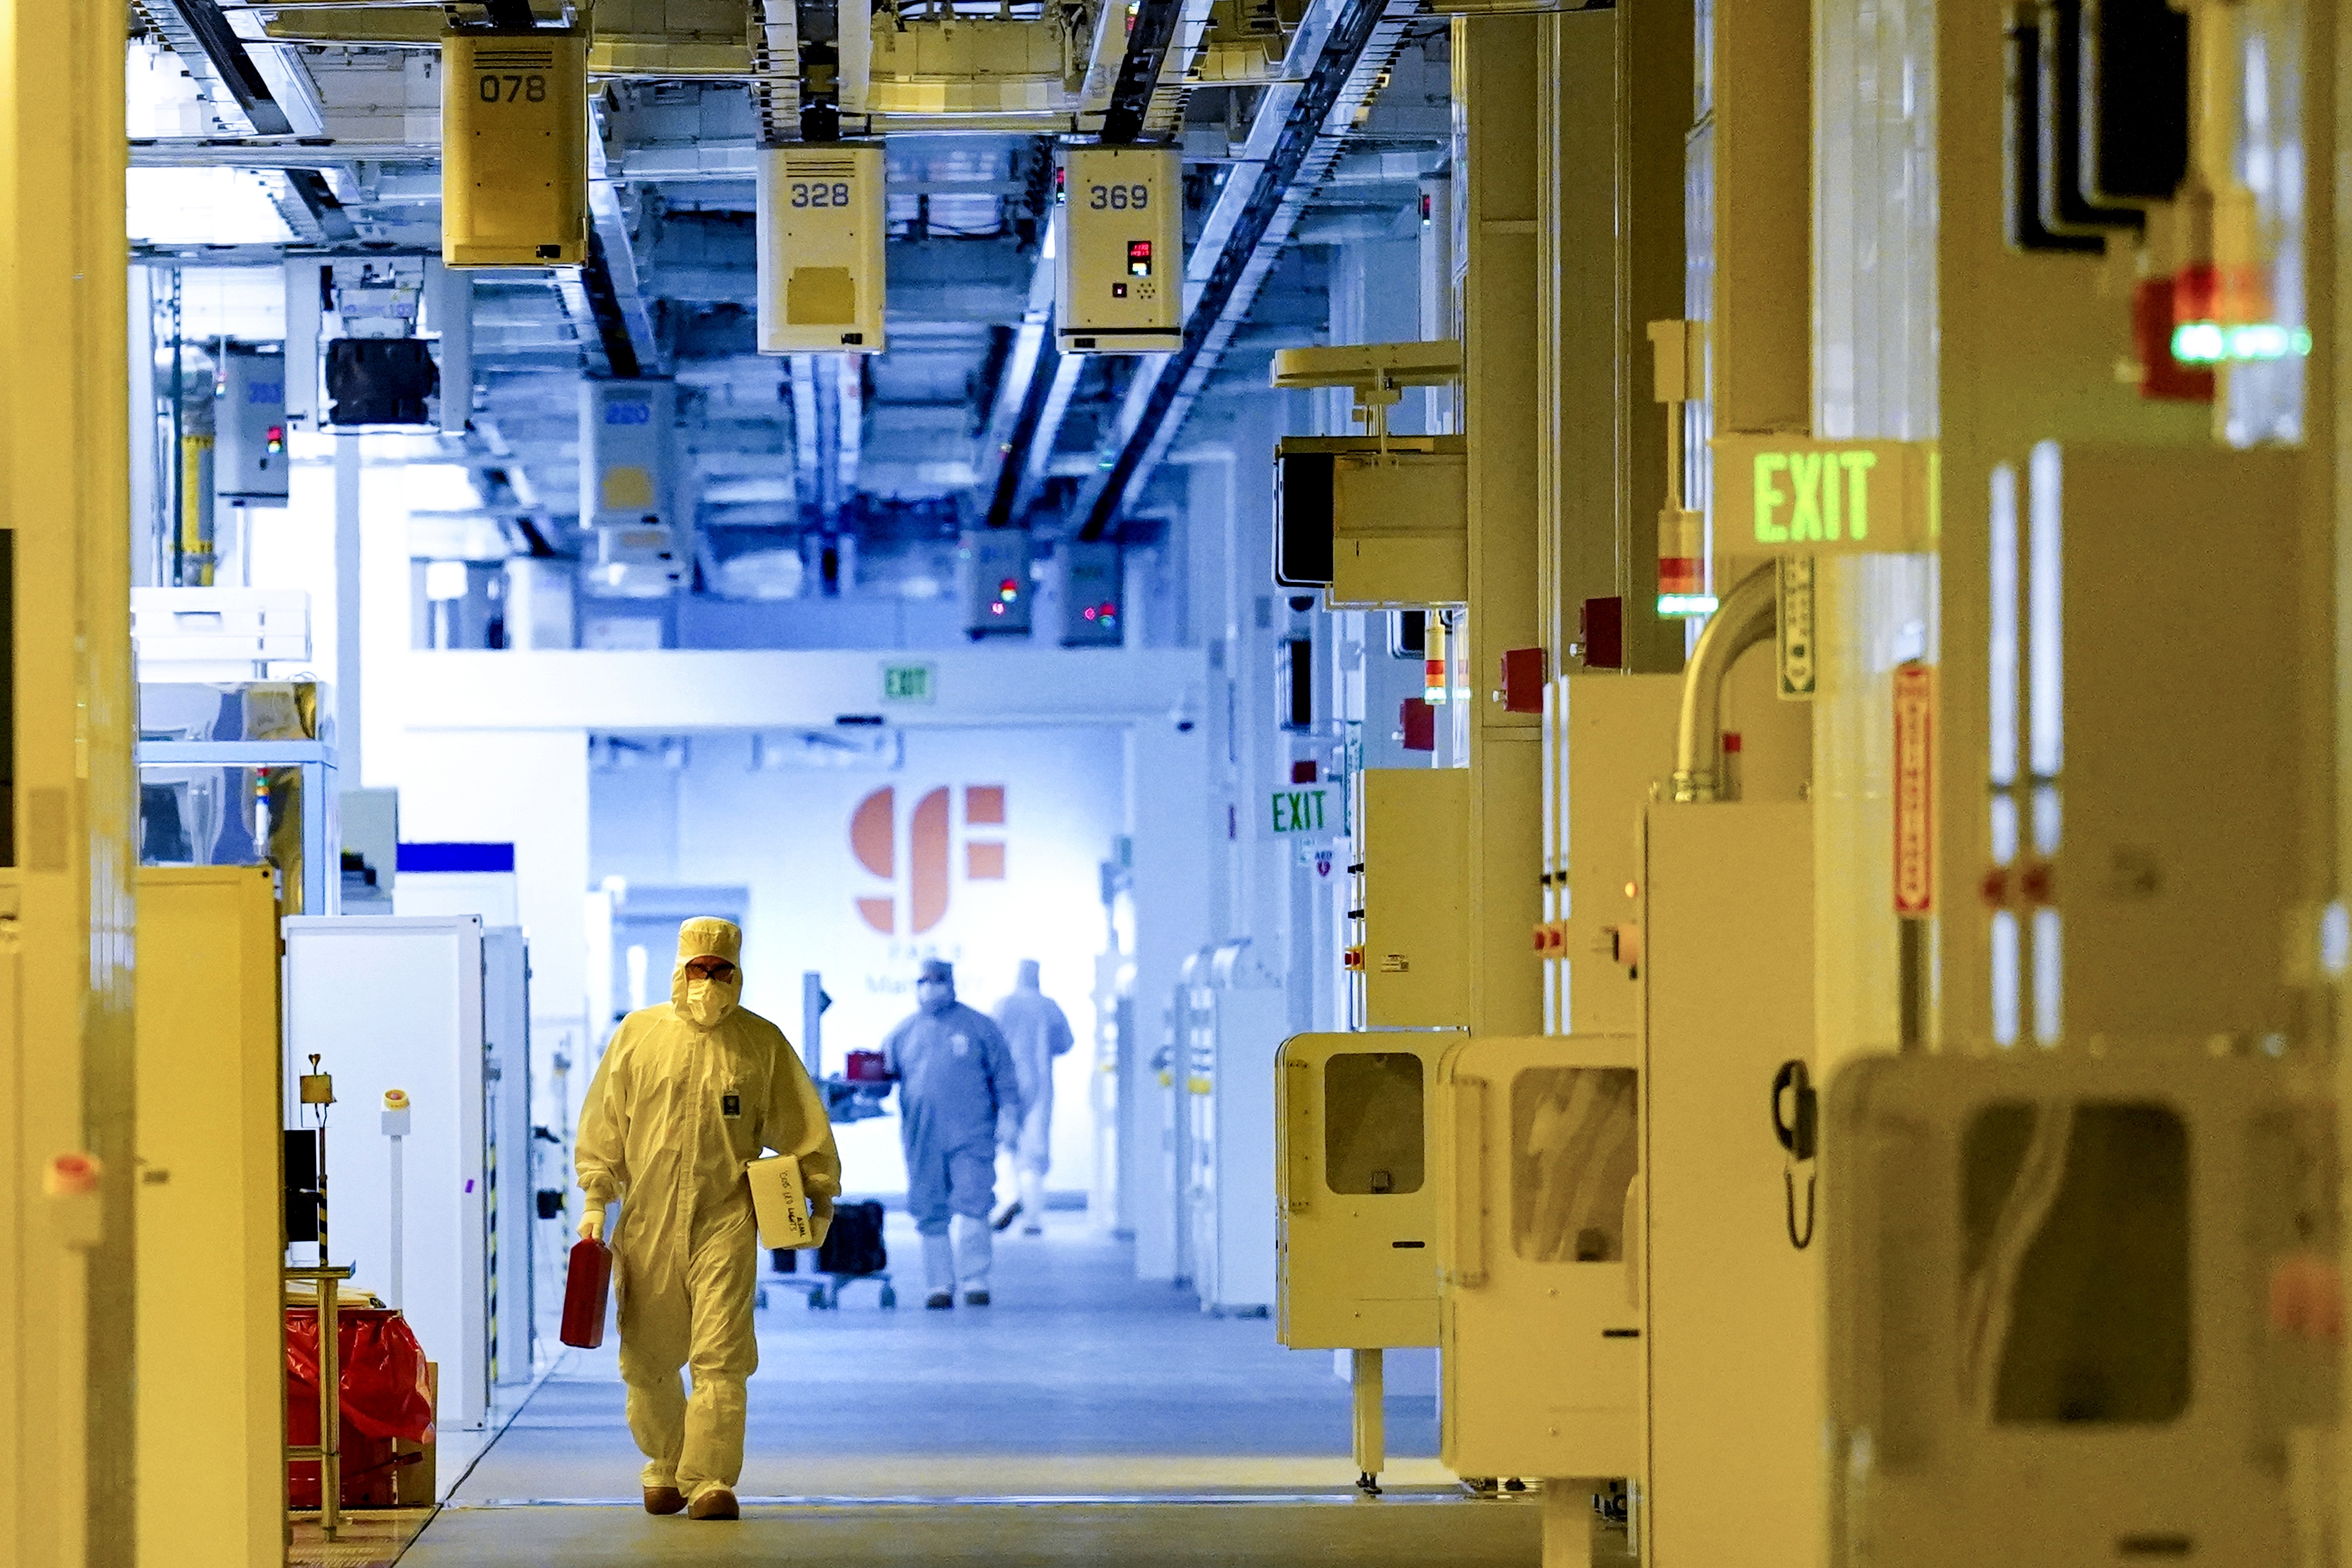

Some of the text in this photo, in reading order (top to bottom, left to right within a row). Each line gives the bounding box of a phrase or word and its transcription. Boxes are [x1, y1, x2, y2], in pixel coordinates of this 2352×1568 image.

[480, 75, 546, 102] 078
[792, 183, 849, 207] 328
[1091, 185, 1147, 209] 369
[1753, 450, 1878, 543] EXIT
[1272, 791, 1326, 832] EXIT
[797, 1217, 806, 1238] ASML
